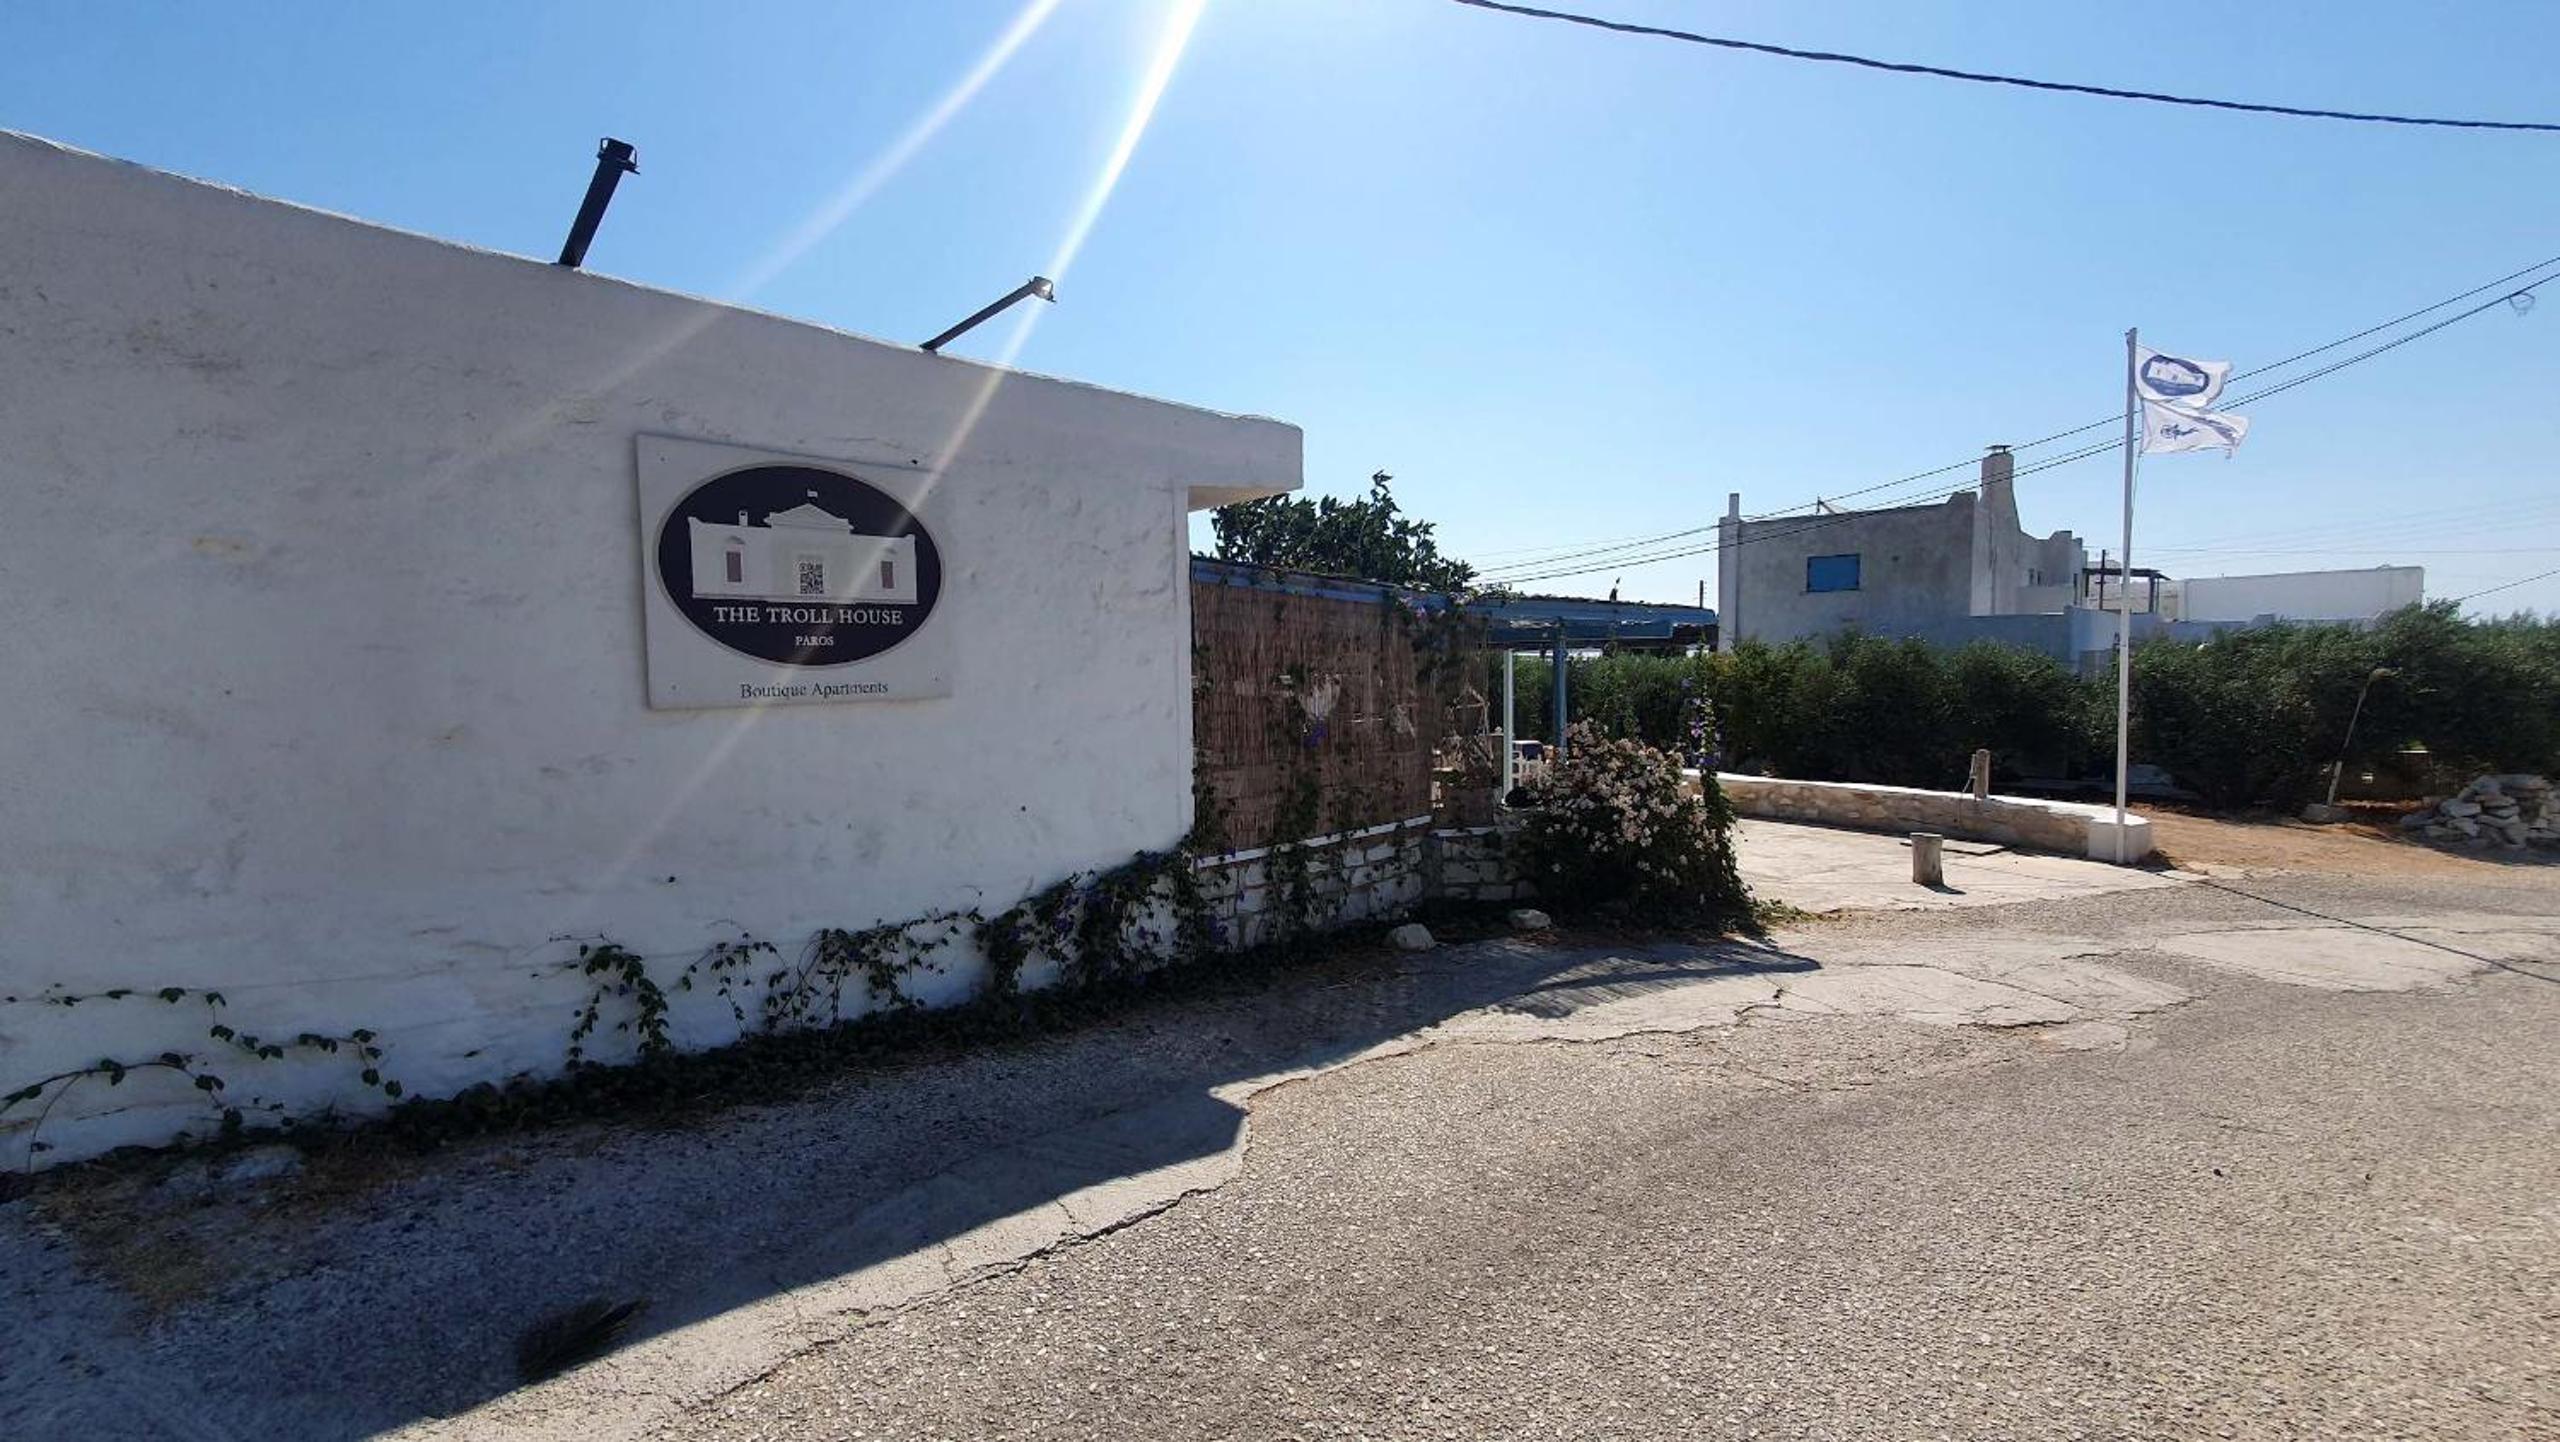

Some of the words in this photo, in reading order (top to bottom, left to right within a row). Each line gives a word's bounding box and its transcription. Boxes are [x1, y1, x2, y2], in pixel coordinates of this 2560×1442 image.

[713, 606, 760, 623] THE
[766, 607, 833, 624] TROLL
[839, 608, 904, 625] HOUSE
[795, 635, 834, 646] PAROS
[740, 683, 806, 699] Boutique
[811, 682, 889, 699] Apartments
